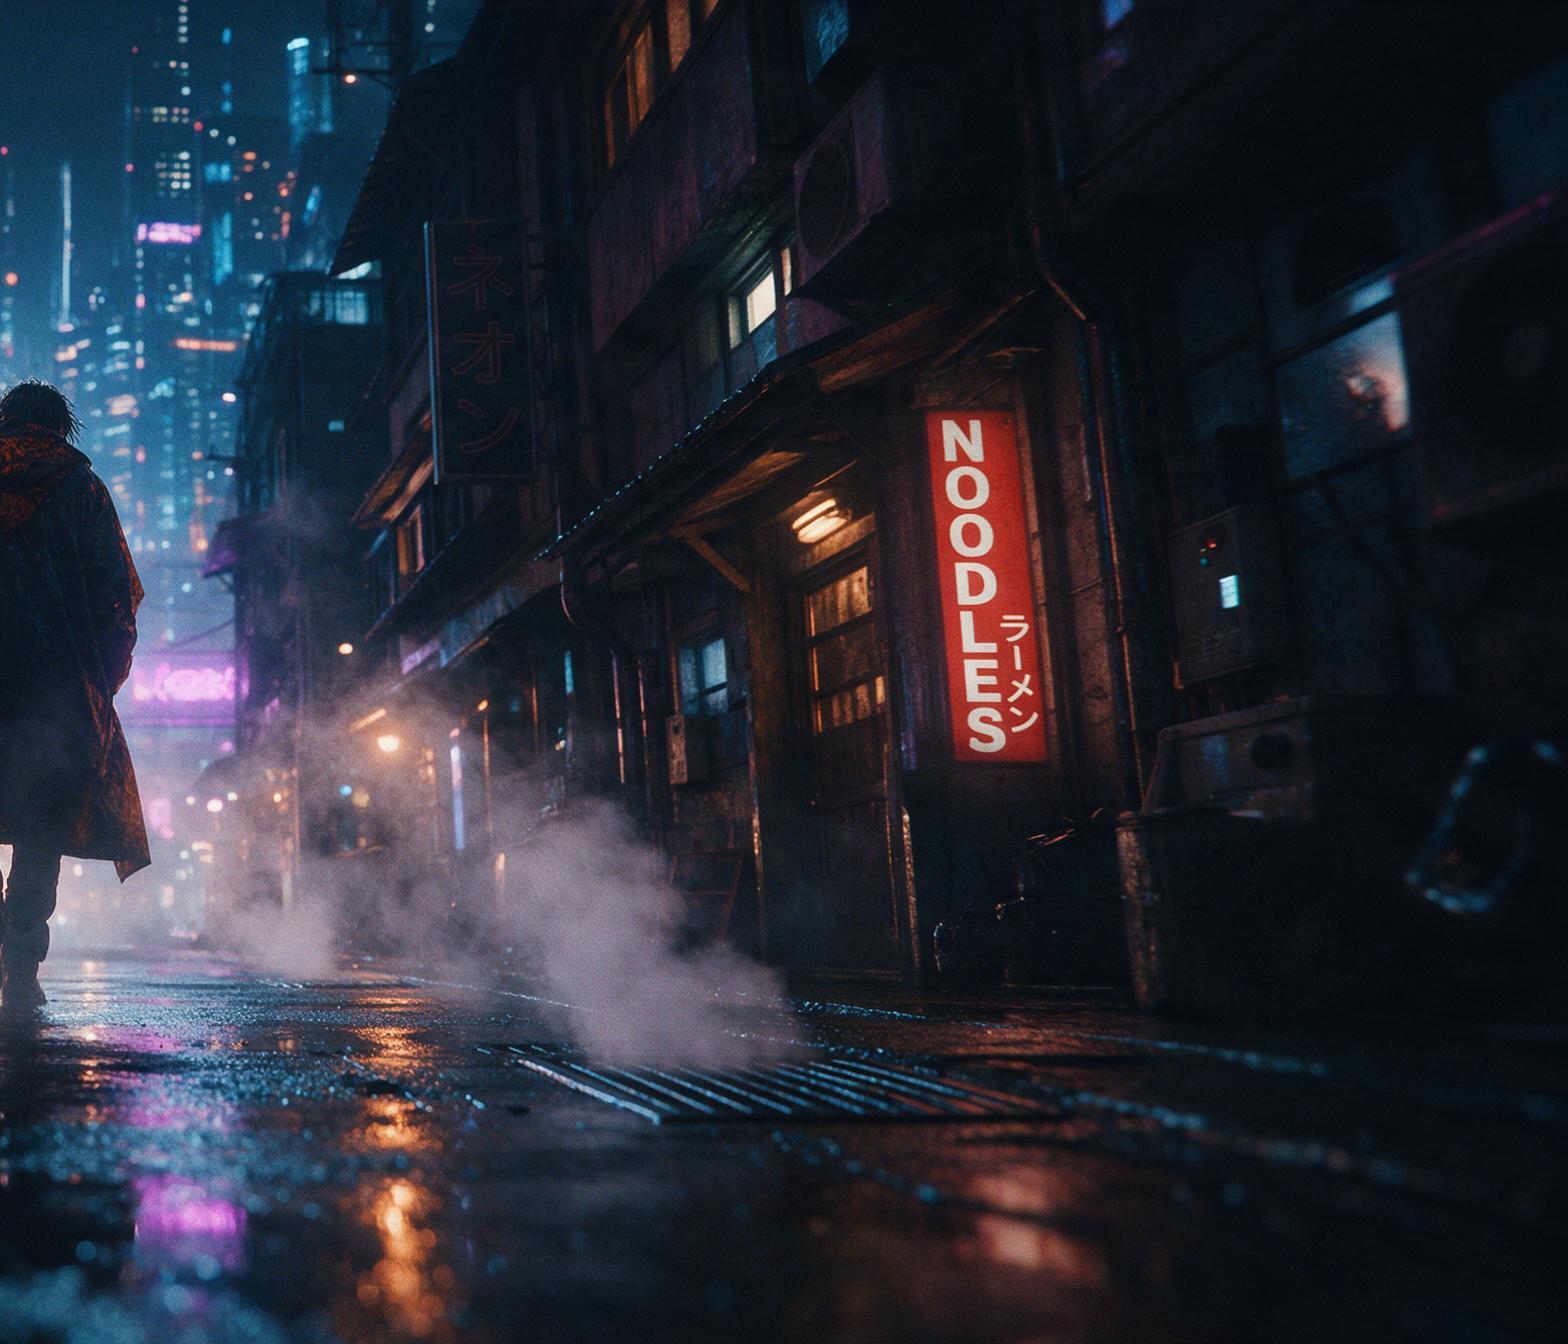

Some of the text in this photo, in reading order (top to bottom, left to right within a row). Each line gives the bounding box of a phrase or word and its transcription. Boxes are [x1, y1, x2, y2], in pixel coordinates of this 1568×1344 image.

[448, 243, 520, 454] ネオン
[941, 419, 1007, 753] NOODLES
[1000, 614, 1039, 734] ラーメン
